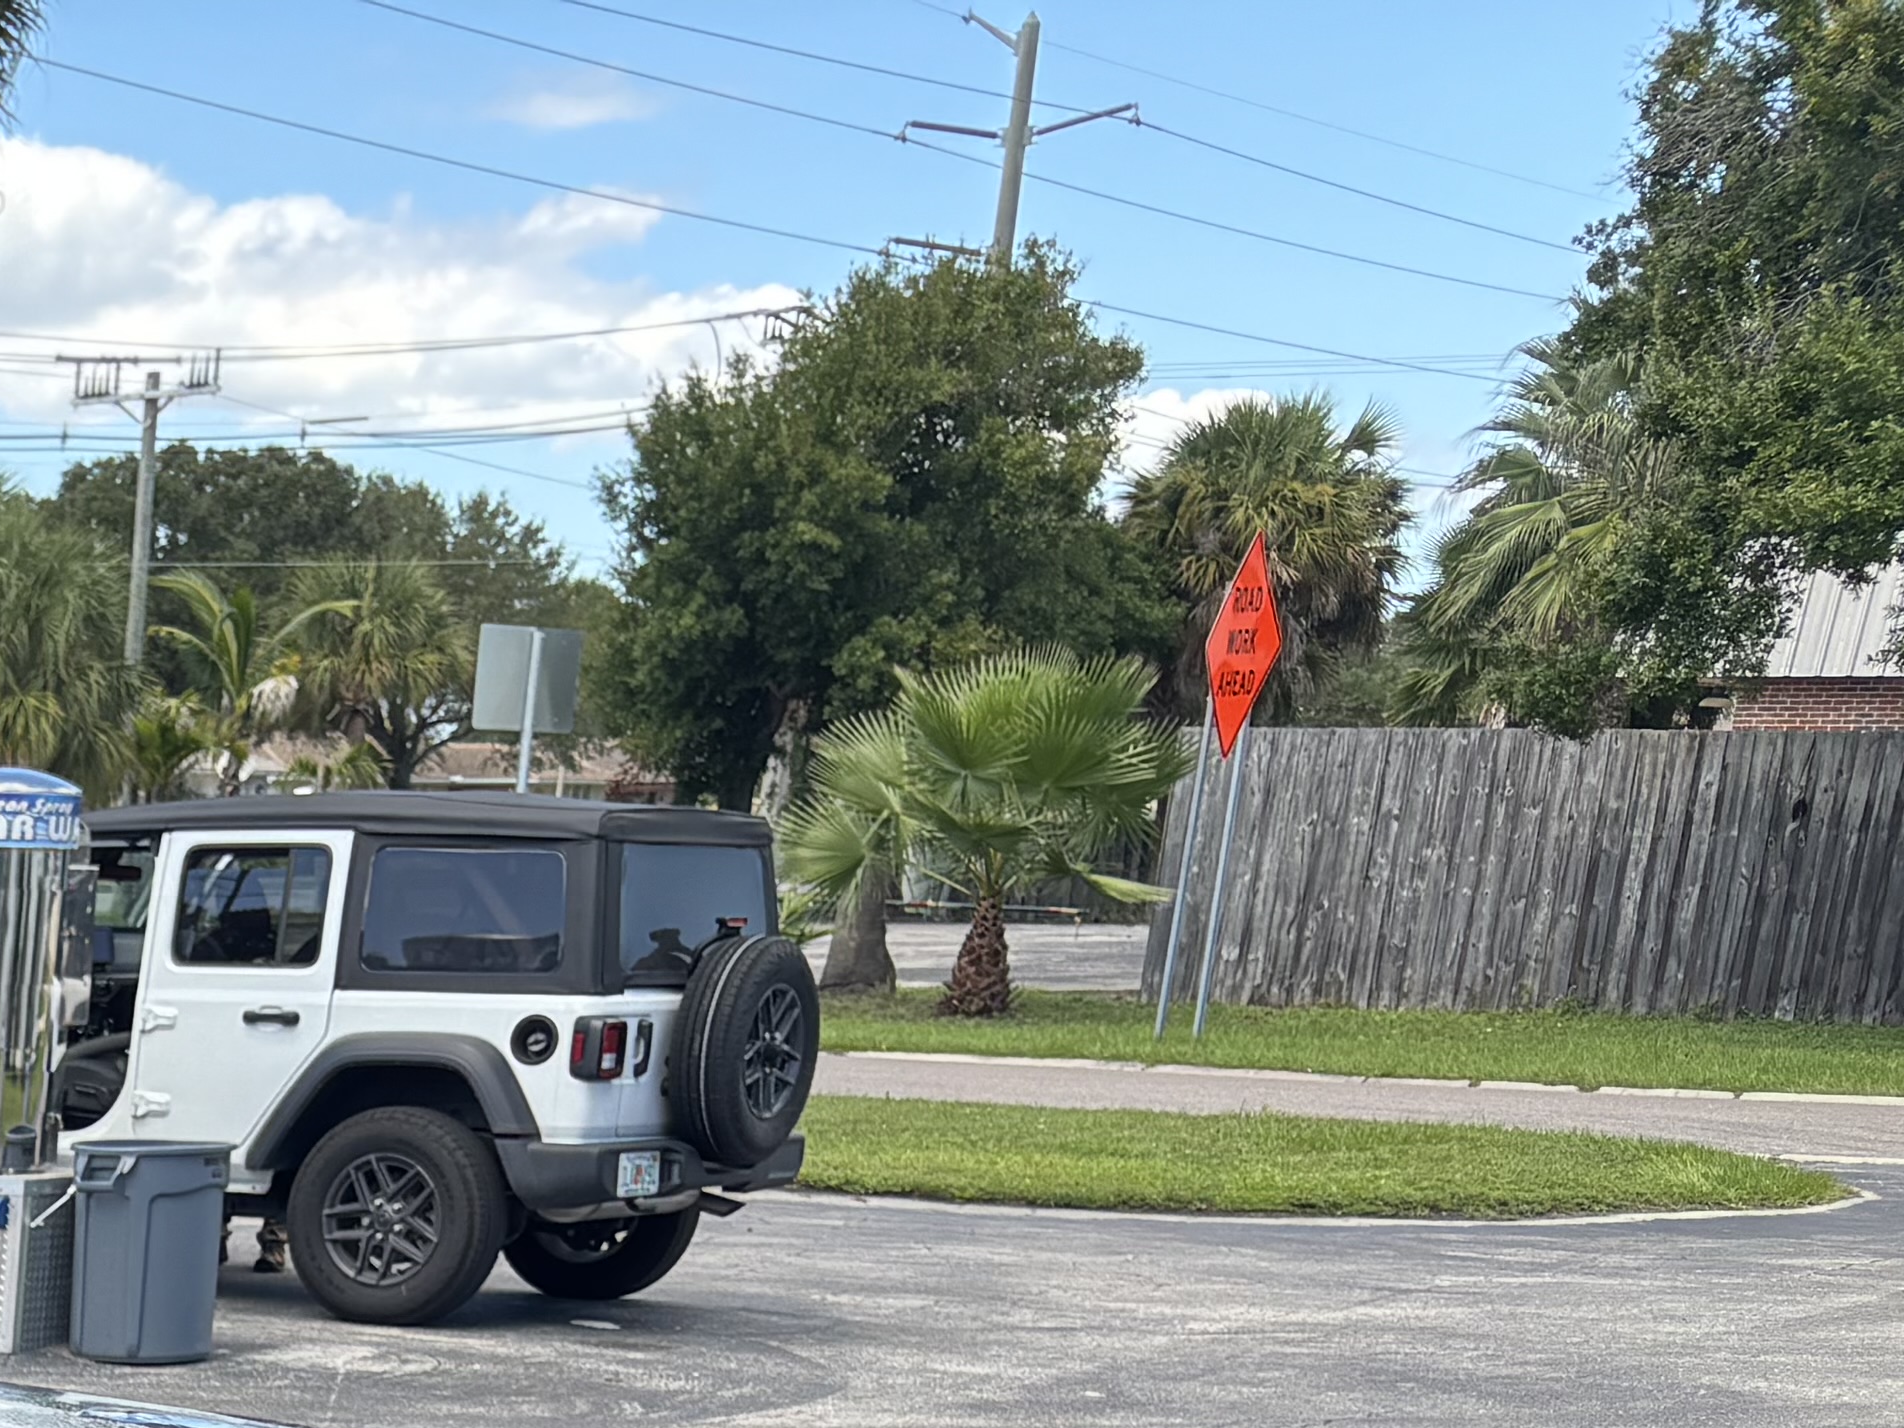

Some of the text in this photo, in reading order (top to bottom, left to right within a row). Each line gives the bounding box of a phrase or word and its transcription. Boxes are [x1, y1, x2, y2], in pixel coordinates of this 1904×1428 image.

[1233, 586, 1263, 613] ROAD
[1226, 628, 1258, 655] WORK
[1215, 669, 1255, 697] AHEAD
